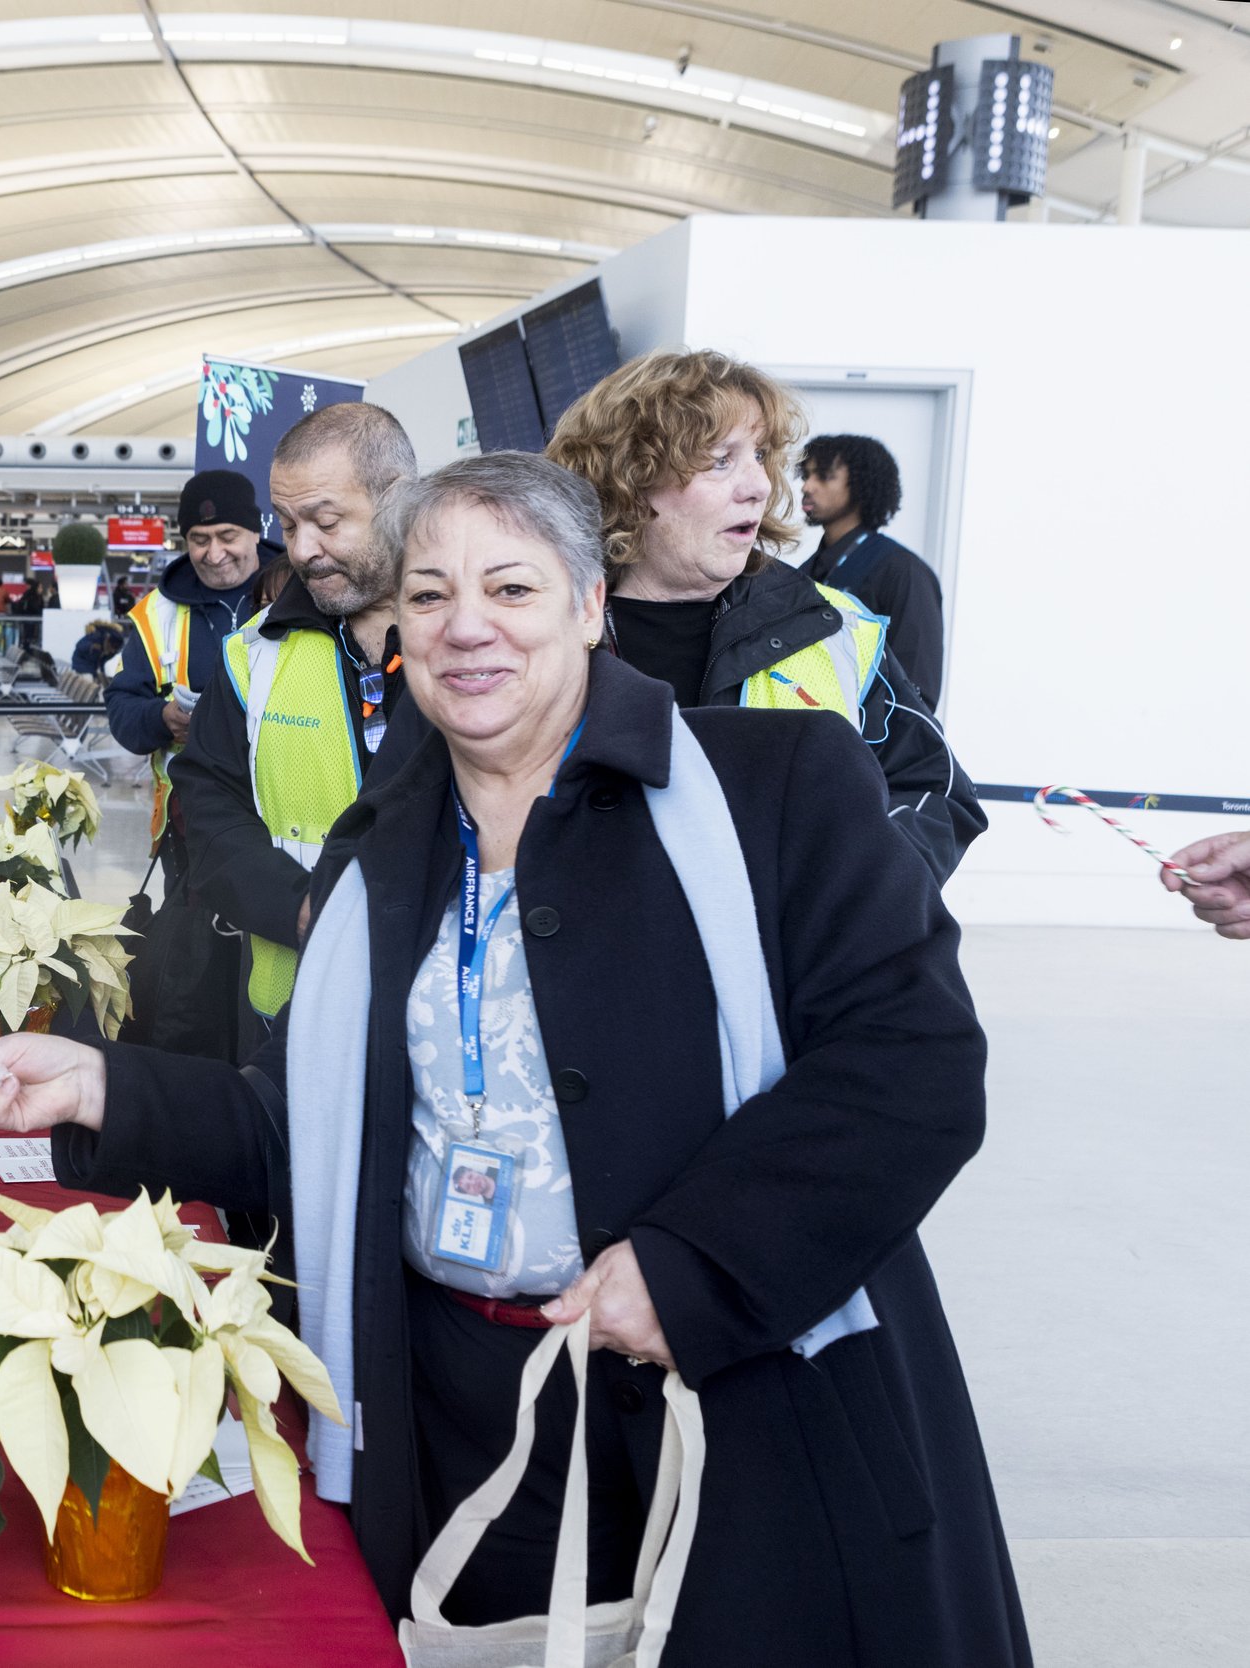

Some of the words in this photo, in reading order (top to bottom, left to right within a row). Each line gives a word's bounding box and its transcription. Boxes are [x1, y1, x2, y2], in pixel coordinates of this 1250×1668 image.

[261, 711, 321, 729] MANAGER
[464, 856, 476, 926] AIRFRANCE
[459, 1210, 475, 1251] KLM
